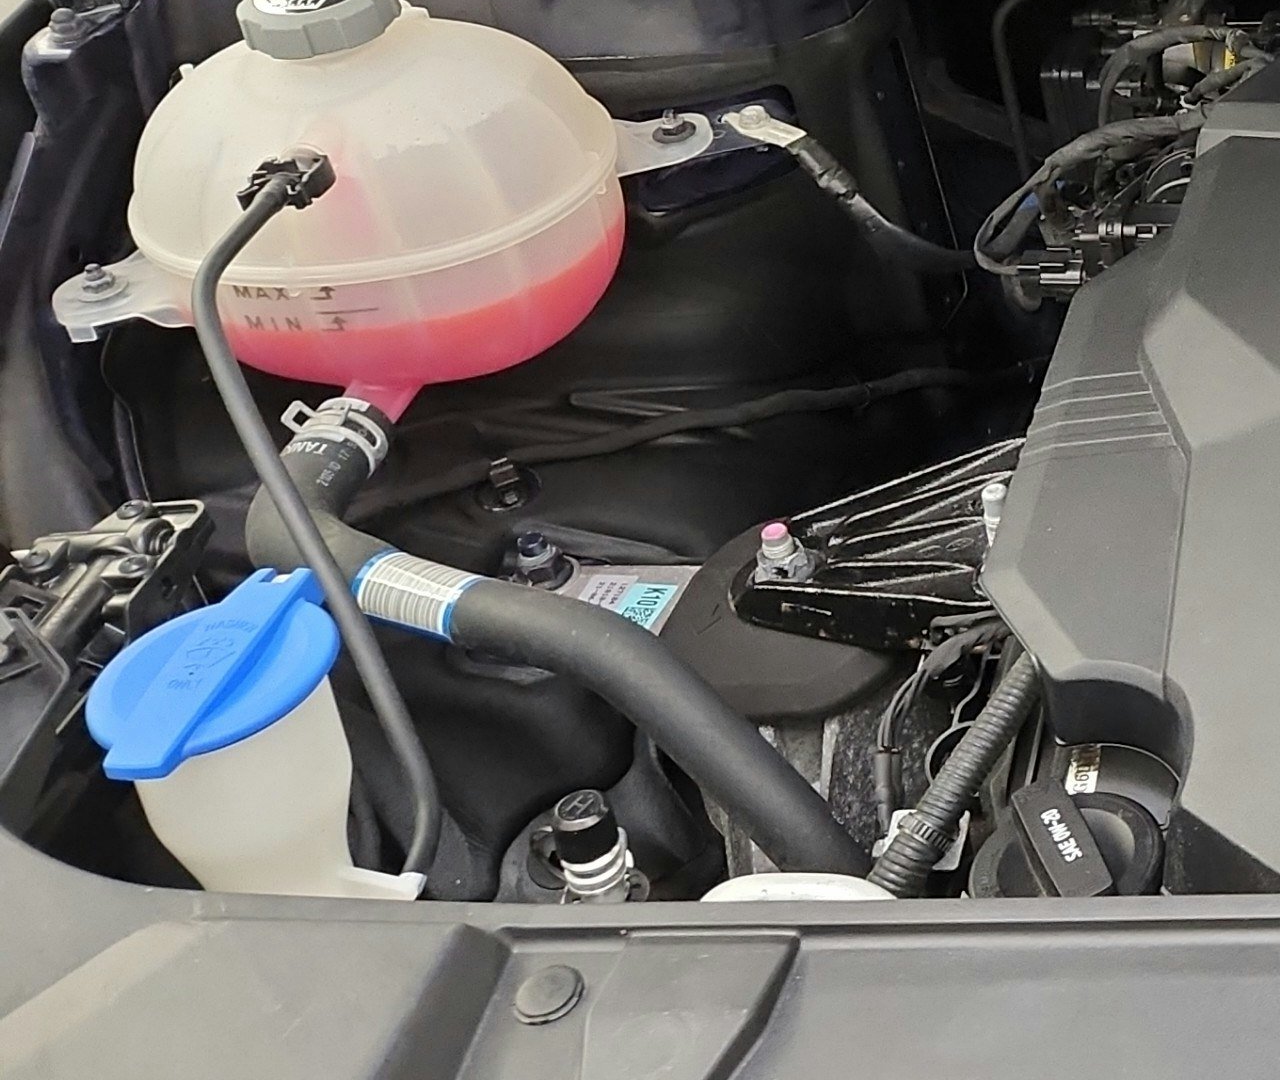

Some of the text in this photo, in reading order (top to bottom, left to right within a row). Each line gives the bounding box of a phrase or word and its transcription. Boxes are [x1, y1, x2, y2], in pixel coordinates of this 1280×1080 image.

[232, 285, 290, 300] MAX
[243, 314, 303, 332] MIN
[636, 587, 668, 607] K10
[1040, 808, 1084, 863] SAE 0W-20
